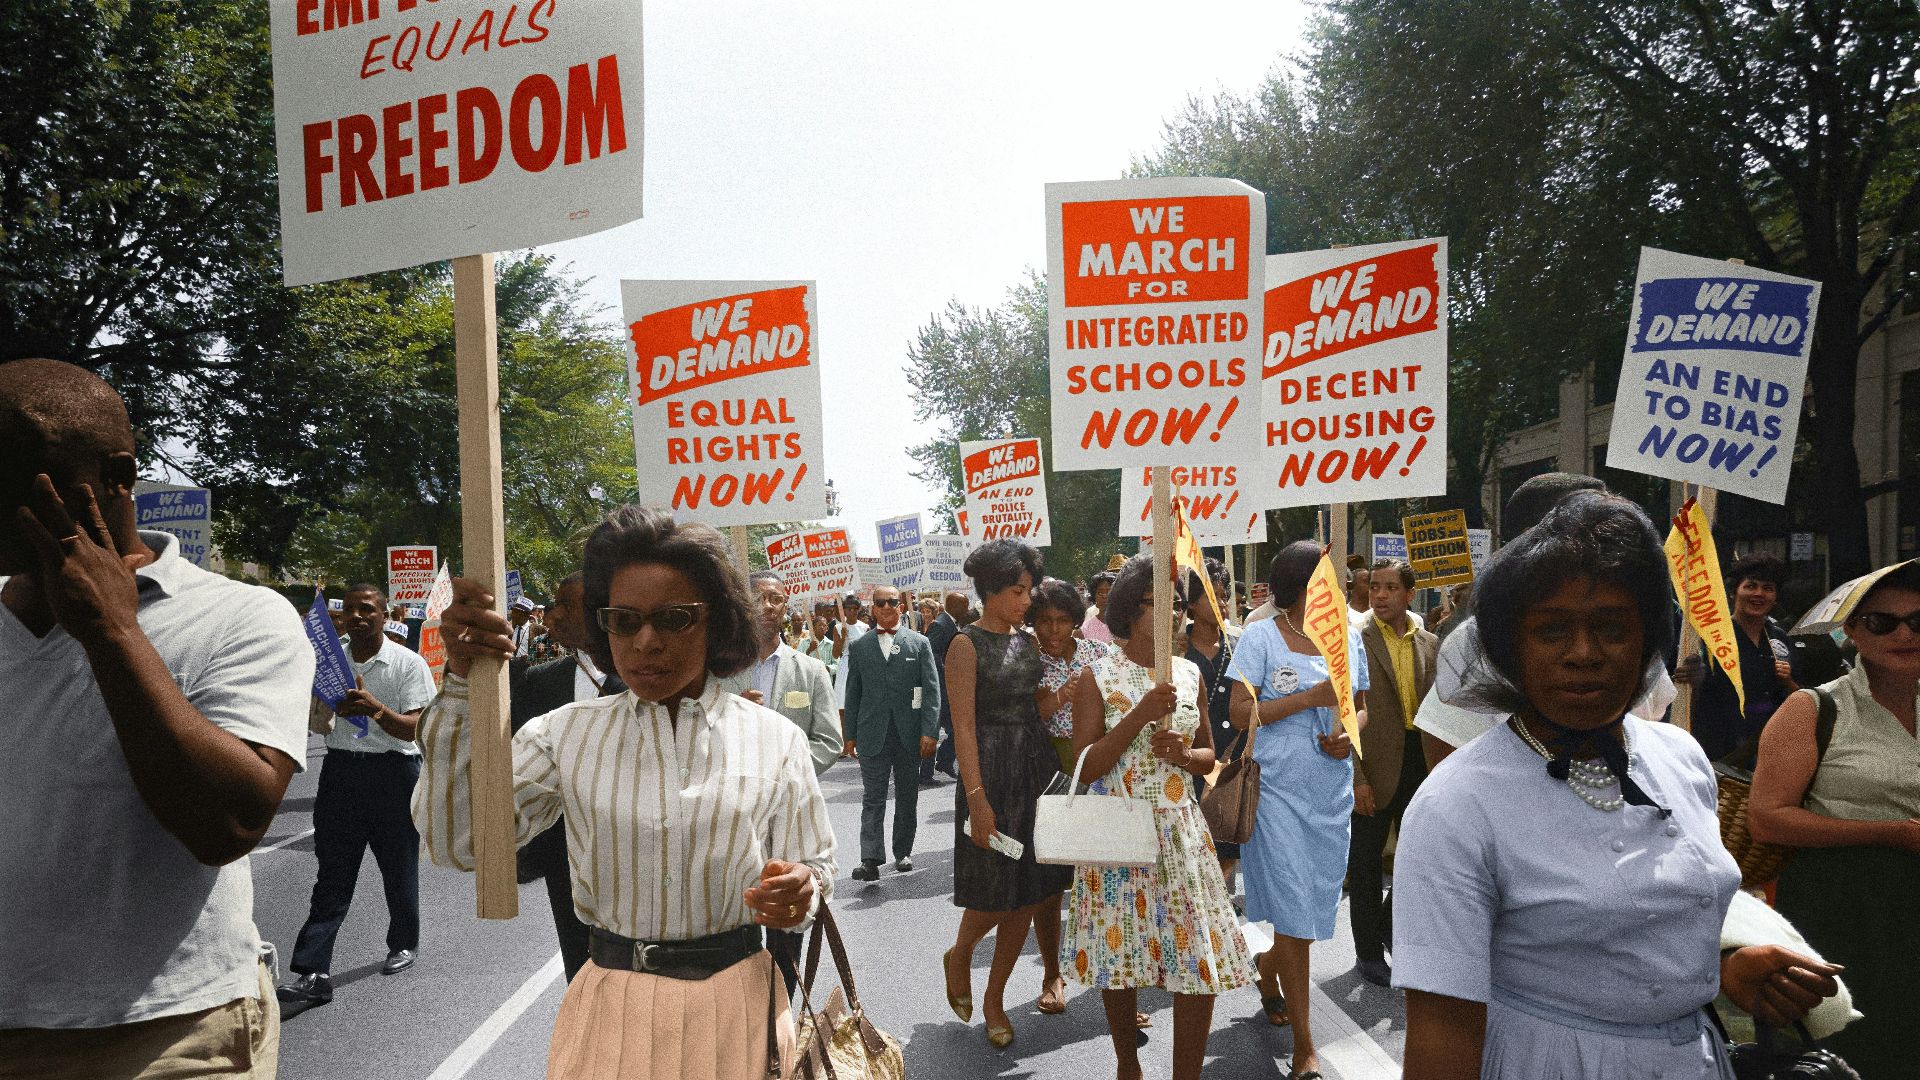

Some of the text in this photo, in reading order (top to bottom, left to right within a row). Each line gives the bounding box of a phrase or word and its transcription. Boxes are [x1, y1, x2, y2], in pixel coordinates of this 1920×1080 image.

[360, 0, 556, 79] EQUALS
[303, 54, 627, 213] FREEDOM
[1129, 205, 1184, 234] WE
[1078, 237, 1235, 277] MARCH
[1128, 280, 1188, 298] FOR
[1310, 263, 1377, 313] WE
[1694, 281, 1760, 311] WE
[691, 298, 752, 342] WE
[1065, 311, 1249, 350] INTEGRATED
[1264, 286, 1432, 368] DEMAND
[1645, 313, 1801, 345] DEMAND
[649, 324, 804, 391] DEMAND
[1067, 358, 1246, 395] SCHOOLS
[1280, 365, 1422, 405] DECENT
[1645, 358, 1789, 408] AN END
[667, 397, 795, 429] EQUAL
[1080, 395, 1239, 450] NOW!
[1644, 390, 1782, 441] TO BIAS
[1266, 405, 1435, 447] HOUSING
[667, 432, 801, 464] RIGHTS
[988, 445, 1016, 465] WE
[1638, 424, 1778, 479] NOW!
[971, 455, 1036, 488] DEMAND
[1278, 434, 1427, 489] NOW!
[671, 462, 807, 511] NOW!
[1143, 465, 1237, 487] RGHTS
[159, 492, 185, 505] WE
[978, 487, 1034, 500] AN END
[142, 503, 204, 521] DEMAND
[982, 512, 1033, 524] BRUTALITY
[991, 502, 1025, 513] POLICE
[818, 532, 832, 541] WE
[885, 528, 917, 545] MARCH
[895, 522, 905, 531] WE
[982, 518, 1042, 541] NOW!
[1410, 526, 1446, 544] JOBS
[781, 535, 798, 549] WE
[809, 538, 845, 552] MARCH
[943, 540, 963, 548] RIGHTS
[1411, 540, 1466, 560] FREEDOM
[394, 557, 431, 565] MARCH
[778, 561, 805, 571] AN EN
[808, 555, 852, 569] INTEGRATED
[884, 552, 903, 564] FIRST
[904, 547, 923, 559] CLASS
[884, 556, 925, 574] CITIZENSHIP
[785, 569, 808, 578] POLICE
[810, 565, 854, 578] SCHOOLS
[817, 574, 853, 592] NOW!
[892, 568, 923, 588] NOW!
[930, 571, 962, 581] REEDOM
[308, 607, 330, 649] MARCH
[1304, 577, 1347, 681] FREEDOM
[1710, 629, 1737, 671] IN '63
